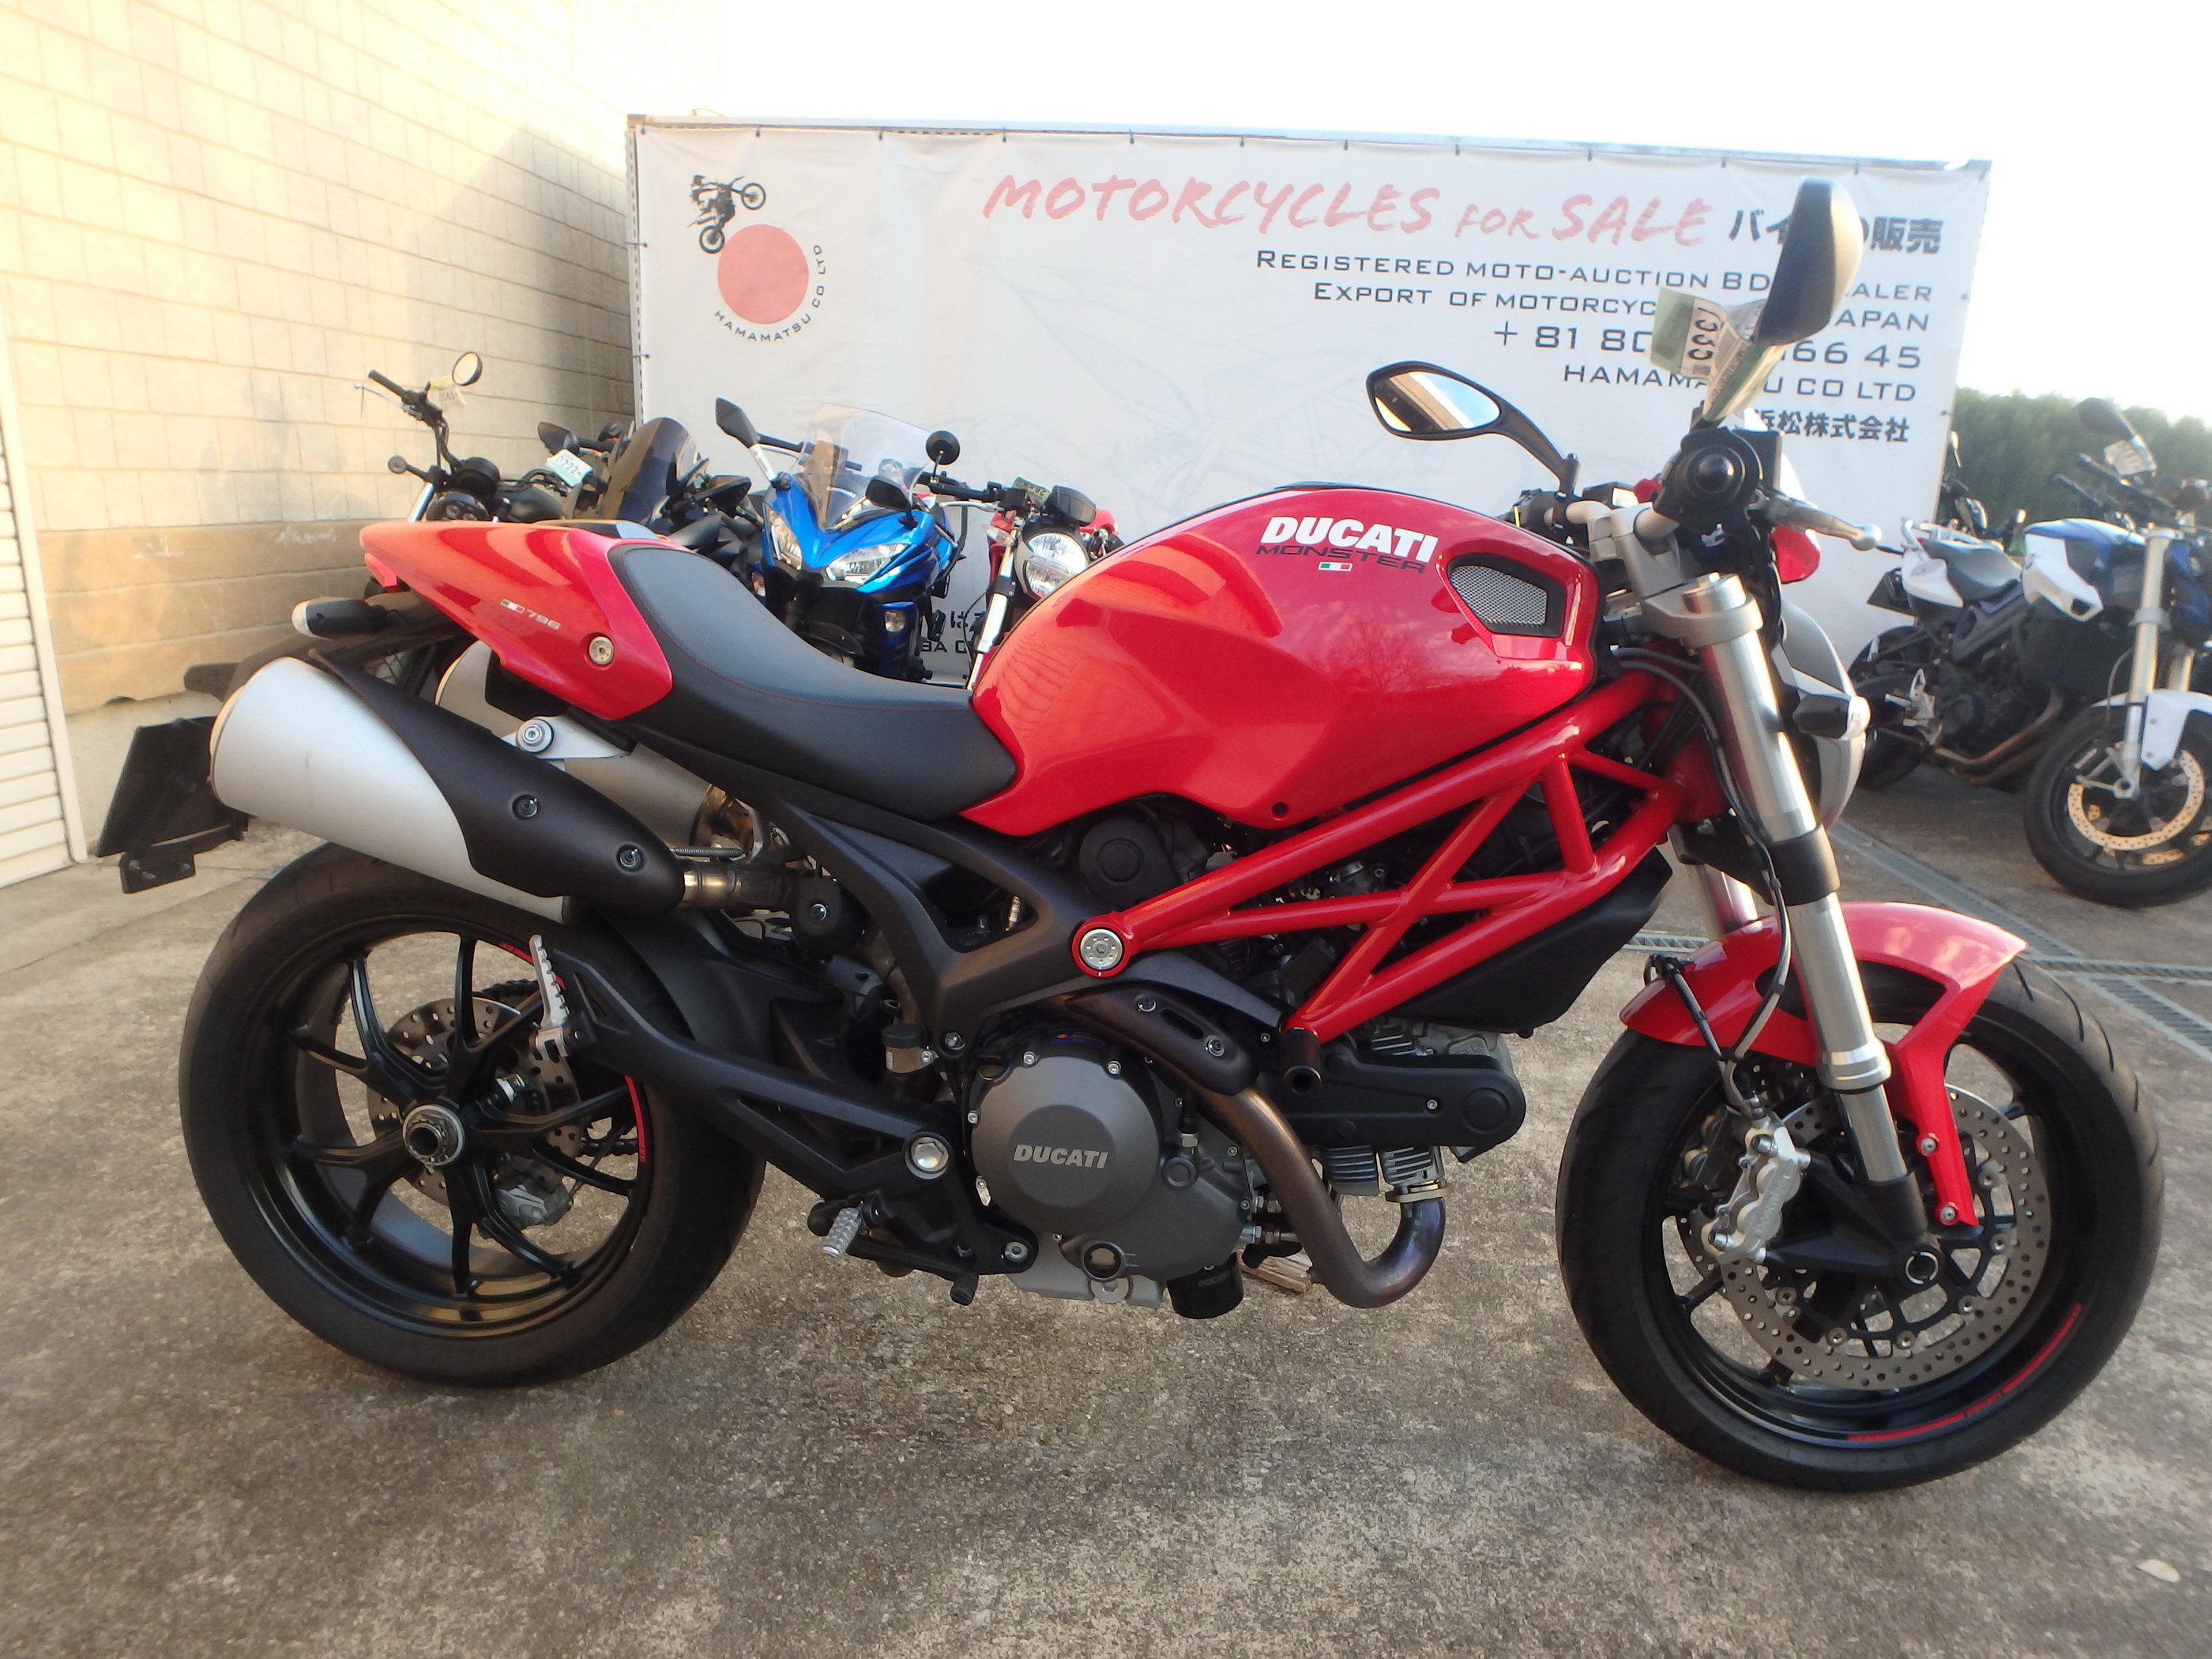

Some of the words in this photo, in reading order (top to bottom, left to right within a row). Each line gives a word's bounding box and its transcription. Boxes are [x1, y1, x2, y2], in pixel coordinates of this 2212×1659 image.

[982, 174, 1440, 235] MOTORCYCLES
[1454, 203, 1540, 239] FOR
[1551, 194, 1714, 246] SALE
[1726, 208, 1944, 255] バイ販売
[812, 244, 826, 275] LTD
[811, 284, 826, 308] CO
[1465, 261, 1709, 289] MOTO-AUCTION
[1721, 271, 1771, 292] BD
[1845, 281, 1932, 303] ALER
[713, 310, 811, 342] HAMAMATSU
[1449, 291, 1487, 308] OF
[1495, 293, 1657, 316] MOTORCYC
[1834, 308, 1929, 332] APAN
[1535, 325, 1577, 349] 81
[1864, 344, 1920, 368] 45
[1563, 363, 1783, 394] HAMAMU
[1796, 377, 1845, 397] CO
[1857, 381, 1917, 402] LTD
[1255, 545, 1427, 574] MONSTER
[1259, 516, 1439, 564] DUCATI
[1013, 1144, 1108, 1169] DUCATI
